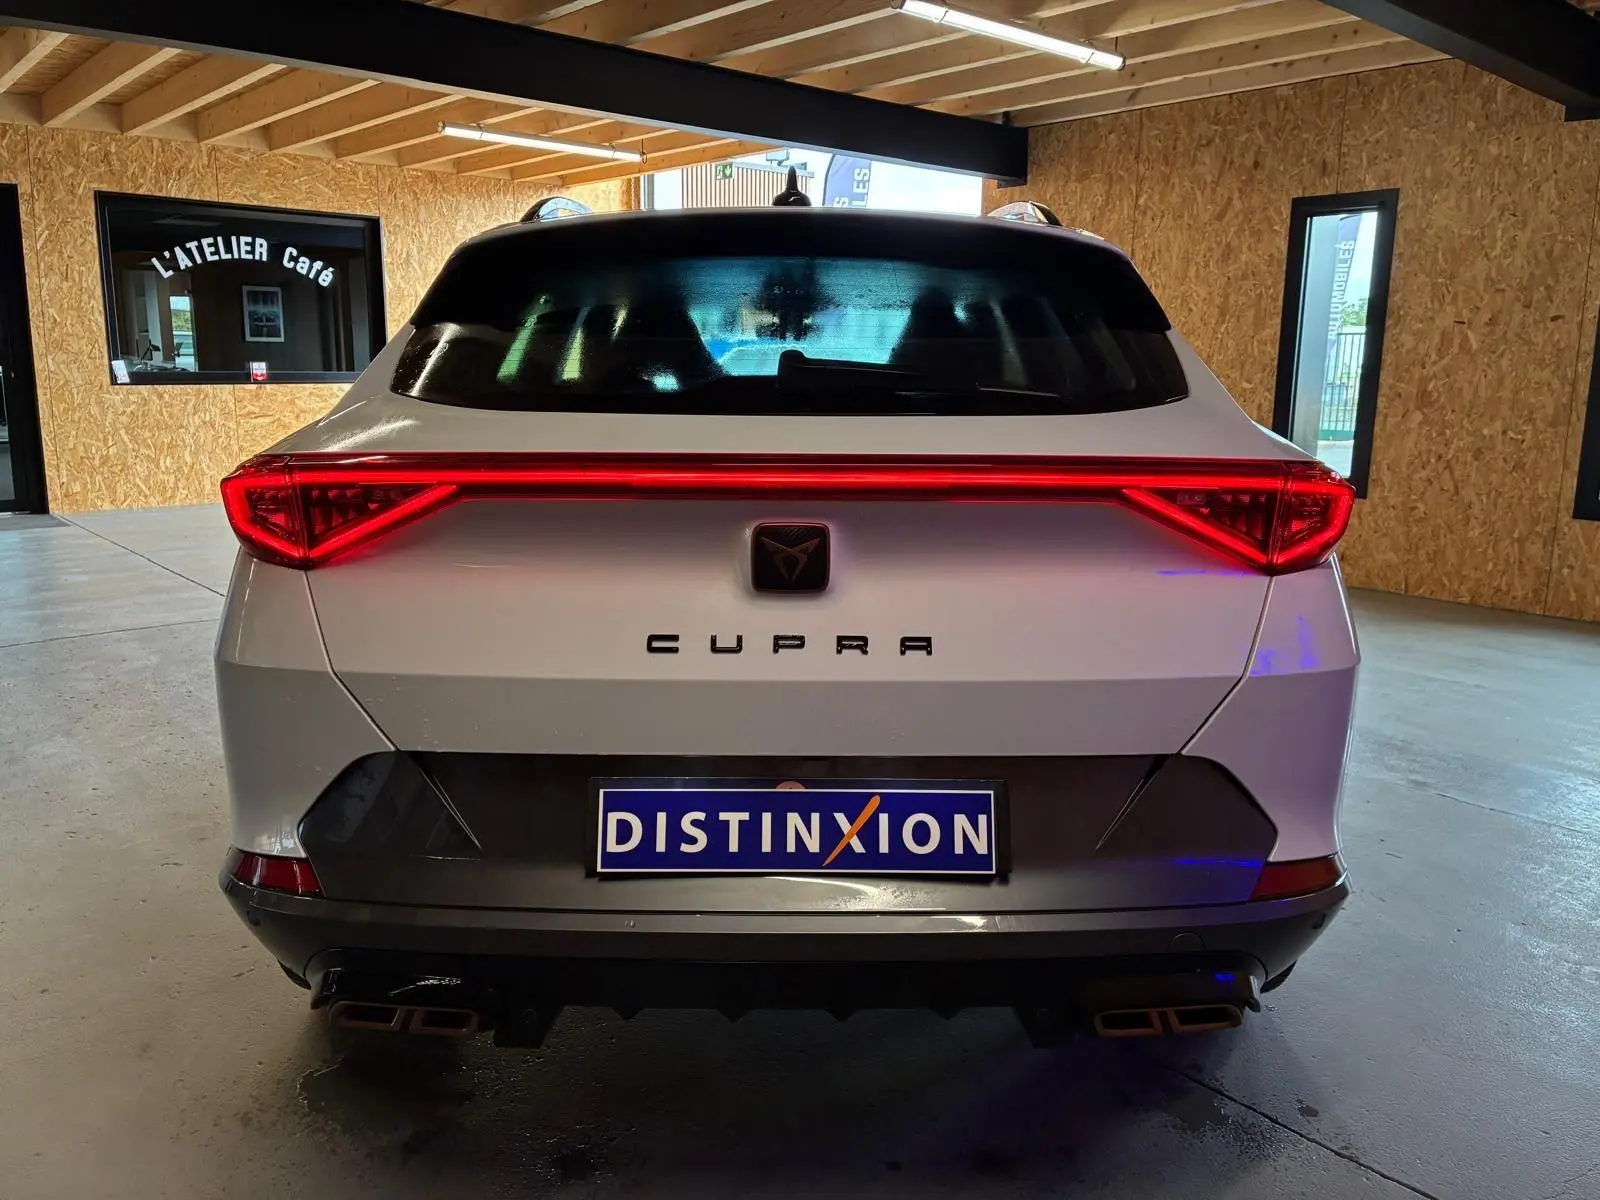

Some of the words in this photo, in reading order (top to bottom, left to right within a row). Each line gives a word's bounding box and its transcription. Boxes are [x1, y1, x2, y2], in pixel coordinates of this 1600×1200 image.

[151, 236, 268, 279] L'ATELIER
[282, 246, 334, 287] Café
[646, 634, 933, 656] CUPRA
[606, 796, 989, 866] DISTINXION
